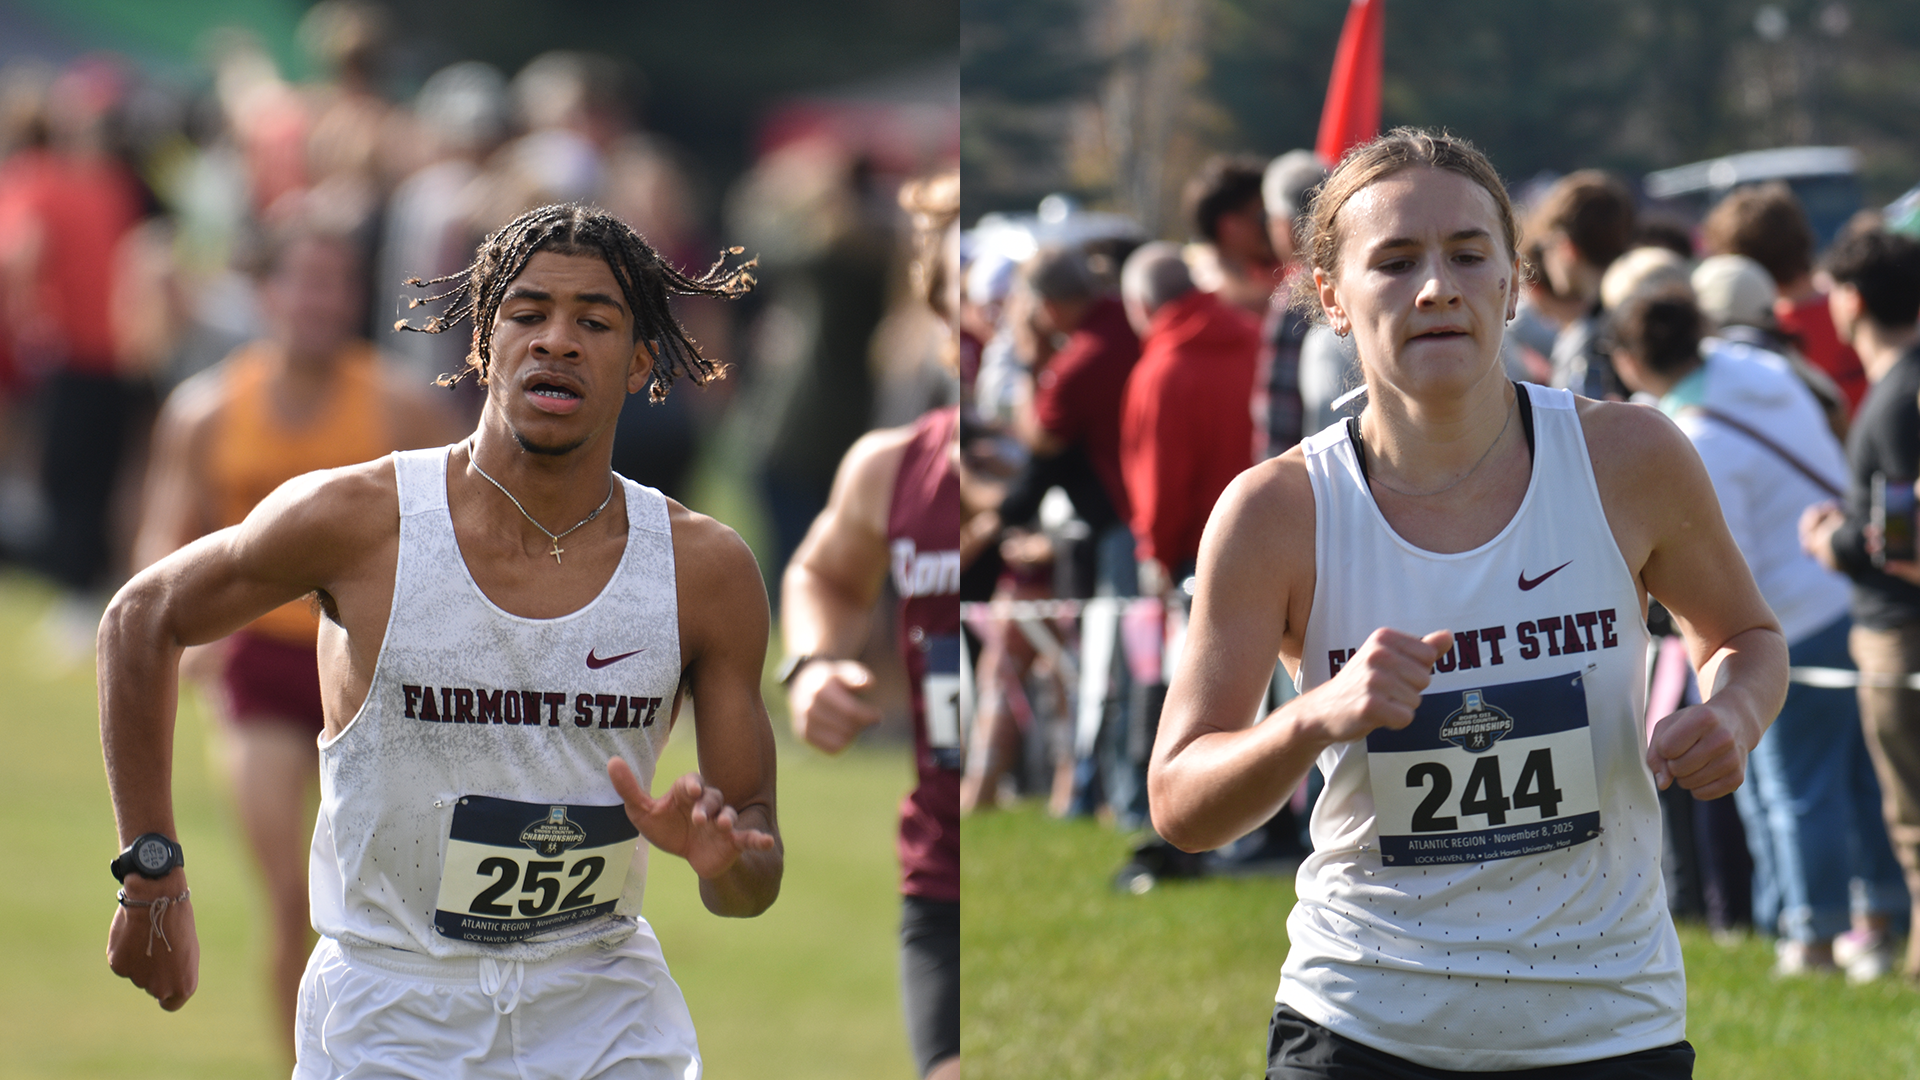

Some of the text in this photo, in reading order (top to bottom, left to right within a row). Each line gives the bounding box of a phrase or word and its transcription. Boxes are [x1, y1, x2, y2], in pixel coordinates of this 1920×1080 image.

[1328, 608, 1618, 680] FONT STATE
[403, 684, 663, 729] FAIRMONT STATE
[1442, 720, 1511, 737] CHAMPIONSHIPS
[1472, 716, 1499, 724] COUNTRY
[1405, 747, 1563, 833] 244
[522, 832, 584, 842] CHAMPIONSHIPS
[1408, 822, 1574, 850] ATLANTIC REGION November 8, 2025
[1415, 855, 1435, 864] LOCK
[1436, 854, 1465, 862] HAVEN,
[1484, 850, 1500, 859] Lock
[1500, 848, 1521, 857] Haven
[1522, 843, 1556, 854] University,
[1556, 839, 1571, 847] Host
[468, 856, 606, 917] 252
[461, 918, 499, 931] ATLANTIC
[501, 921, 531, 932] REGION
[535, 914, 571, 928] November
[580, 908, 597, 917] 2025
[463, 933, 482, 942] LOCK
[483, 935, 509, 943] HAVEN,
